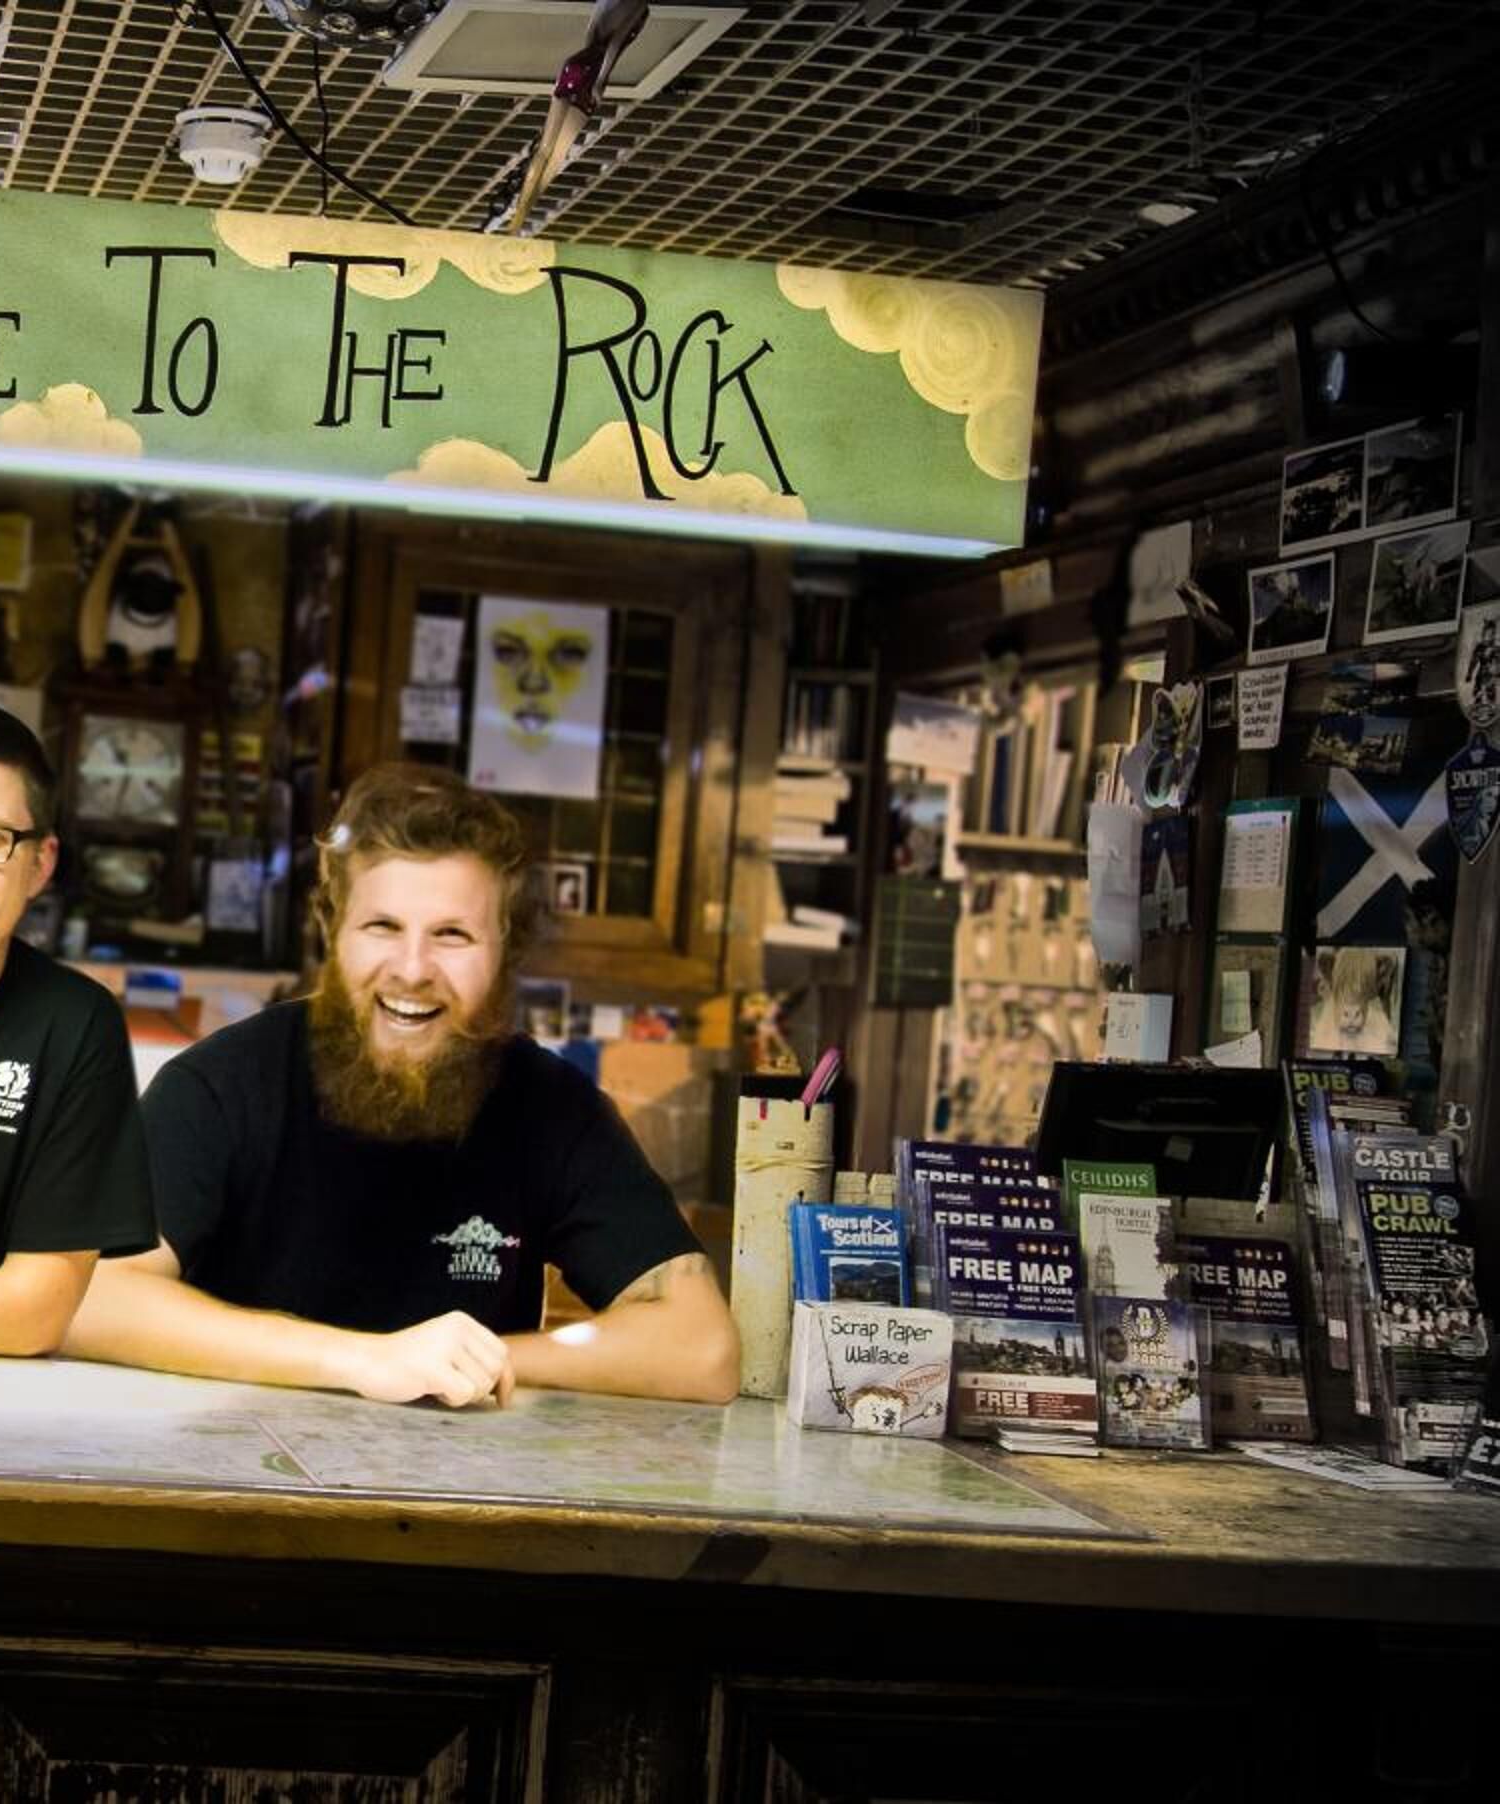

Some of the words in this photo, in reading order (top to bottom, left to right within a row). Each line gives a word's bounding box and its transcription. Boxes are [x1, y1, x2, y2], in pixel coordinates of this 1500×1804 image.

[106, 246, 218, 418] TO
[288, 252, 447, 429] THE
[527, 266, 799, 501] ROCK
[1292, 1071, 1349, 1091] PUB
[1354, 1150, 1451, 1169] CASTLE
[1071, 1170, 1149, 1188] CEILIDHS
[1376, 1169, 1431, 1181] TOUR
[1368, 1193, 1431, 1215] PUB
[816, 1212, 859, 1232] Tours
[1372, 1215, 1458, 1235] CRAWL
[832, 1229, 899, 1247] Scotland
[948, 1256, 1013, 1282] FREE
[1019, 1261, 1073, 1285] MAP
[1188, 1263, 1231, 1286] REE
[1236, 1266, 1288, 1290] MAP
[1043, 1285, 1073, 1296] TOURS
[831, 1315, 879, 1342] Scrap
[887, 1319, 933, 1345] Paper
[845, 1345, 910, 1366] Wallace
[975, 1390, 1029, 1409] FREE
